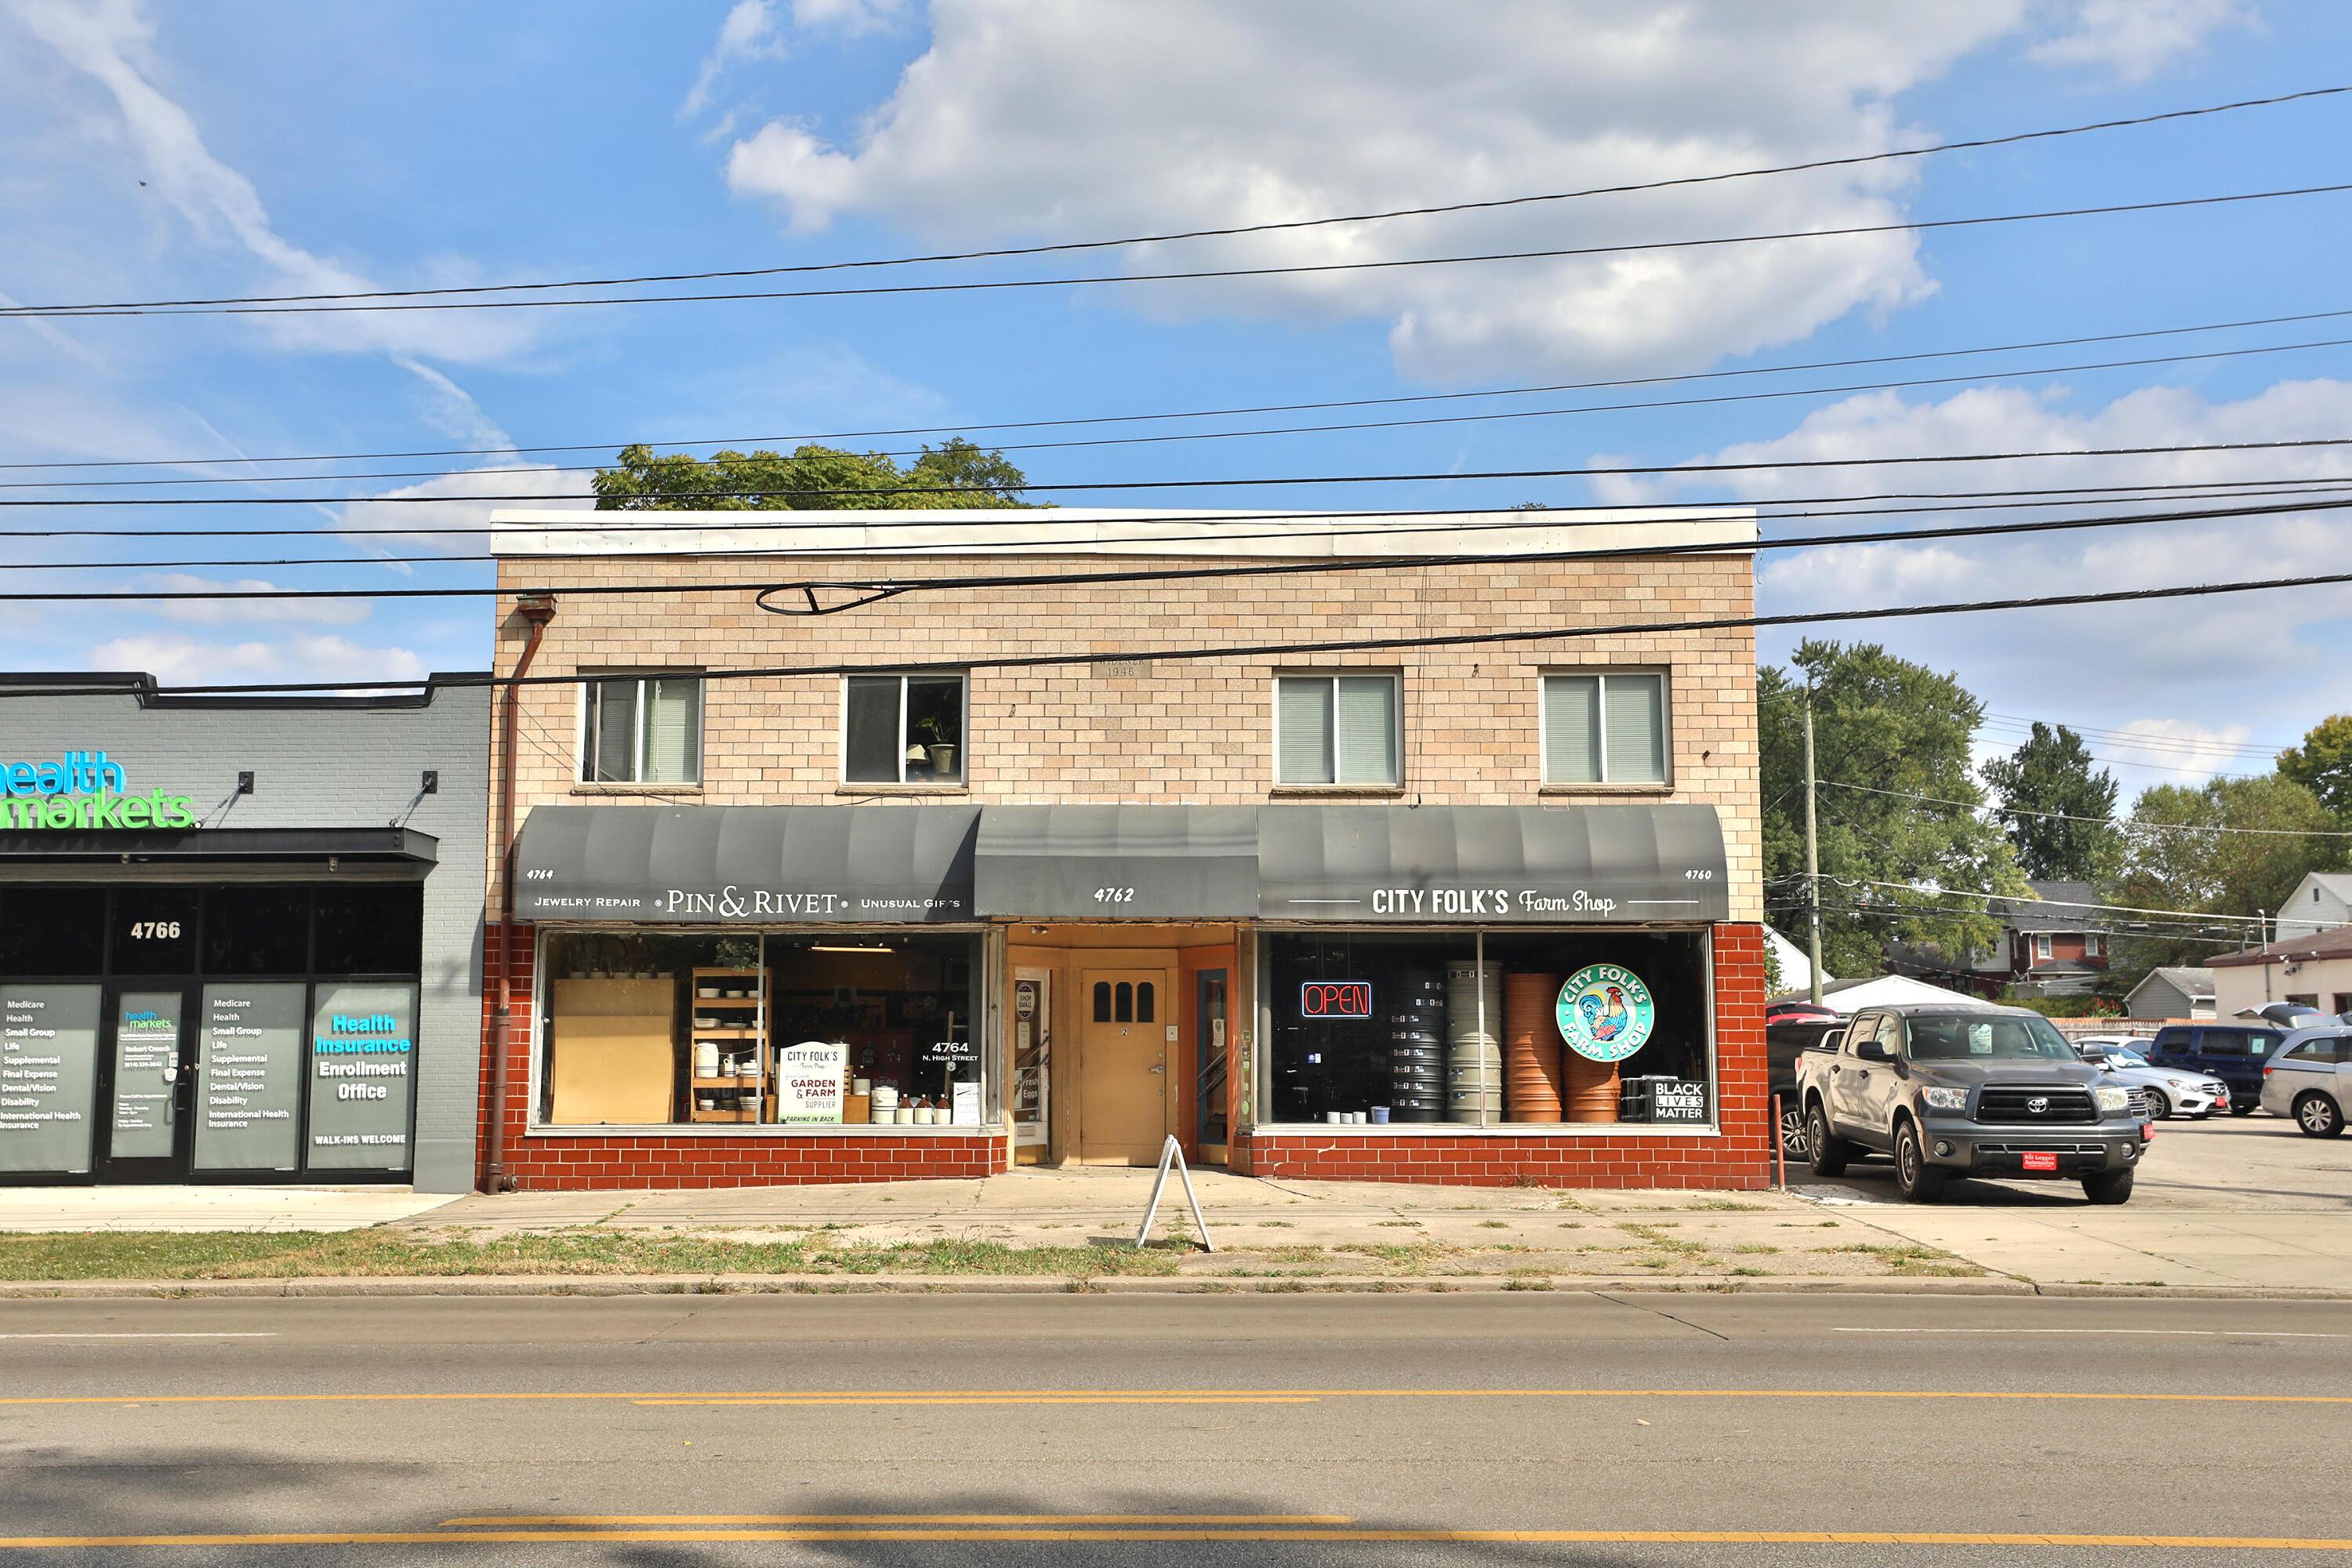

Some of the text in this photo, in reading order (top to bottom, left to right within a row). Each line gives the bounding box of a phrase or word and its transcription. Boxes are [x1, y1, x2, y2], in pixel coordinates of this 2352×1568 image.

[1108, 667, 1134, 676] 1946
[0, 750, 125, 794] ealth
[0, 787, 194, 829] markets
[527, 869, 554, 880] 4764
[1685, 869, 1712, 880] 4760
[1094, 887, 1134, 902] 4762
[535, 897, 641, 907] JEWELRY REPAIR
[862, 899, 920, 908] UNUSUAL
[1372, 889, 1617, 917] CITY FOLK'S Farm Shop
[131, 921, 180, 939] 4766
[1564, 967, 1647, 1004] CITY FOLK'S
[1305, 985, 1368, 1014] OPEN
[125, 1011, 157, 1020] health
[213, 1013, 240, 1022] Health
[130, 1019, 171, 1028] markets
[333, 1014, 396, 1032] Health
[5, 1028, 56, 1038] Small Group
[212, 1026, 262, 1036] Small Group
[212, 1040, 227, 1049] Life
[316, 1036, 411, 1053] Insurance
[1563, 1022, 1647, 1058] FARM SHOP
[932, 1043, 969, 1053] 4764
[3, 1056, 60, 1065] Supplemental
[211, 1054, 268, 1064] Supplemental
[787, 1051, 838, 1062] CITY FOLK'S
[231, 1069, 266, 1078] Expense
[319, 1061, 407, 1076] Enrollment
[2, 1069, 58, 1080] Final Expense
[2, 1083, 56, 1092] Dental/Vision
[210, 1082, 265, 1091] Dental/Vision
[791, 1080, 836, 1088] GARDEN
[338, 1083, 387, 1099] Office
[1656, 1083, 1703, 1096] BLACK
[1023, 1090, 1038, 1100] Eggs
[1, 1098, 40, 1107] Disability
[209, 1096, 249, 1106] Disability
[1657, 1097, 1702, 1106] LIVES
[0, 1111, 82, 1120] International Health
[262, 1109, 289, 1118] Health
[1656, 1108, 1703, 1119] MATTER
[315, 1134, 406, 1145] WALK-INS WELCOME
